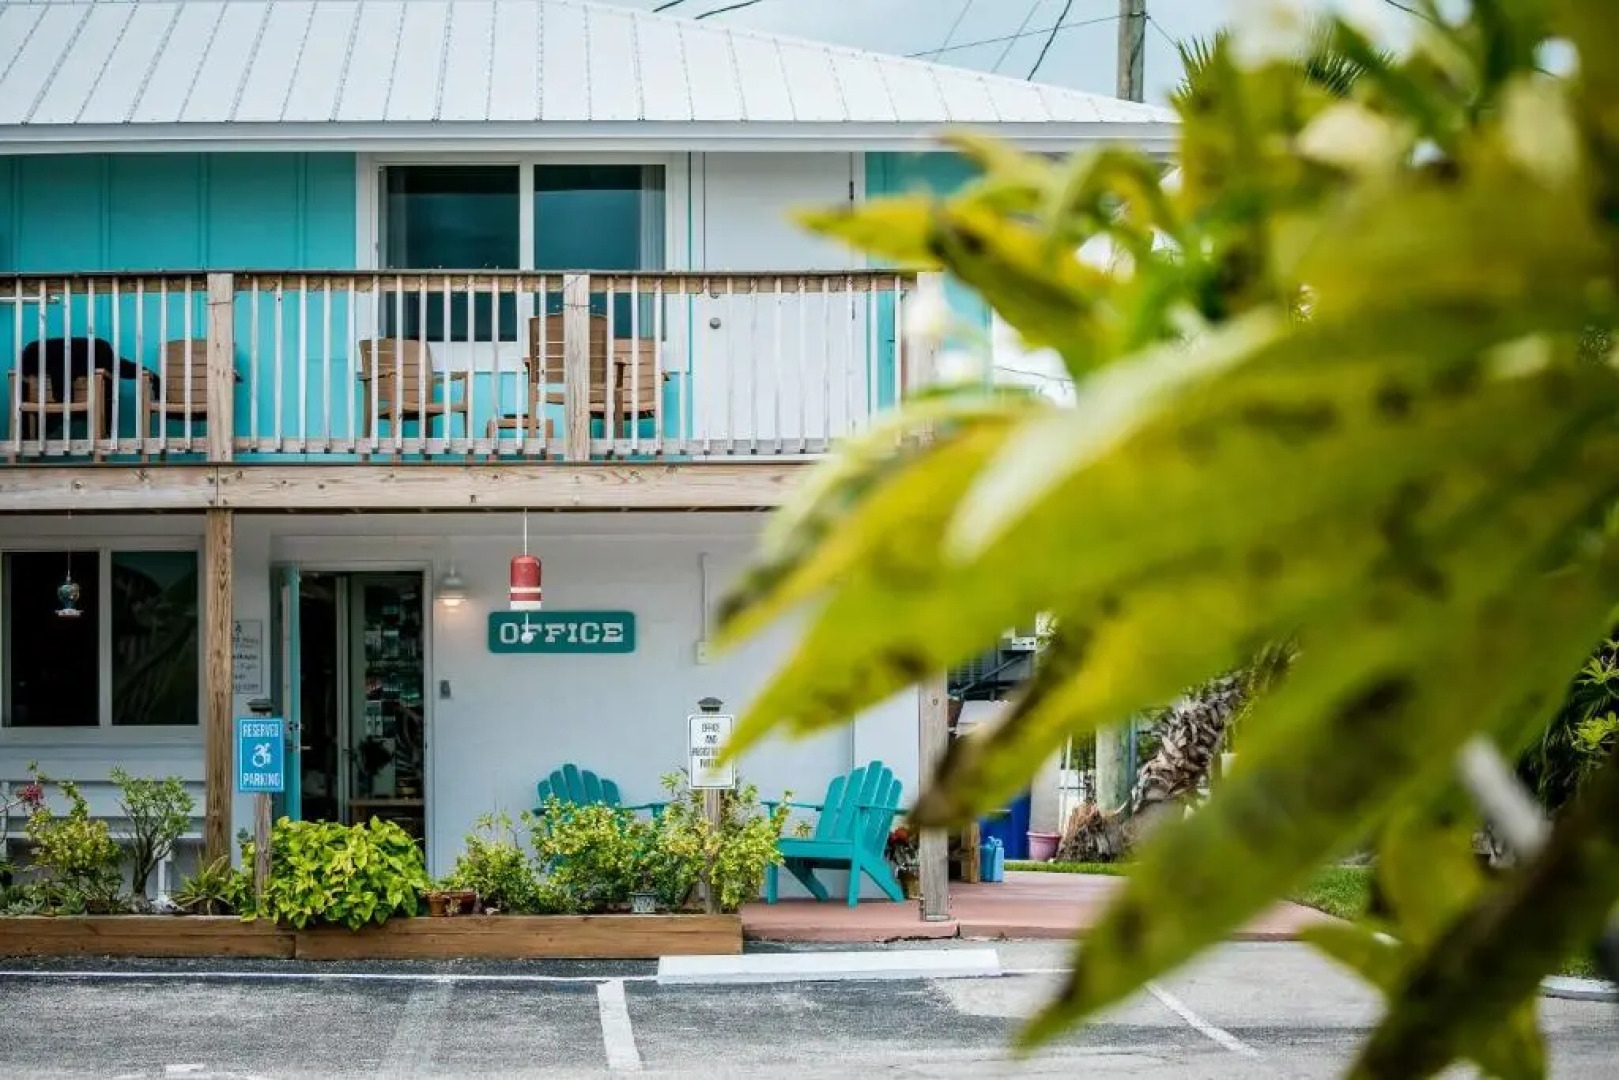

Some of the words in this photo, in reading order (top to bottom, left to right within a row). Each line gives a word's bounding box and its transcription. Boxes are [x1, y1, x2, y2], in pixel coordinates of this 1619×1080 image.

[500, 622, 624, 644] OFFICE
[243, 723, 279, 737] RESERVED
[242, 772, 281, 787] PARKING
